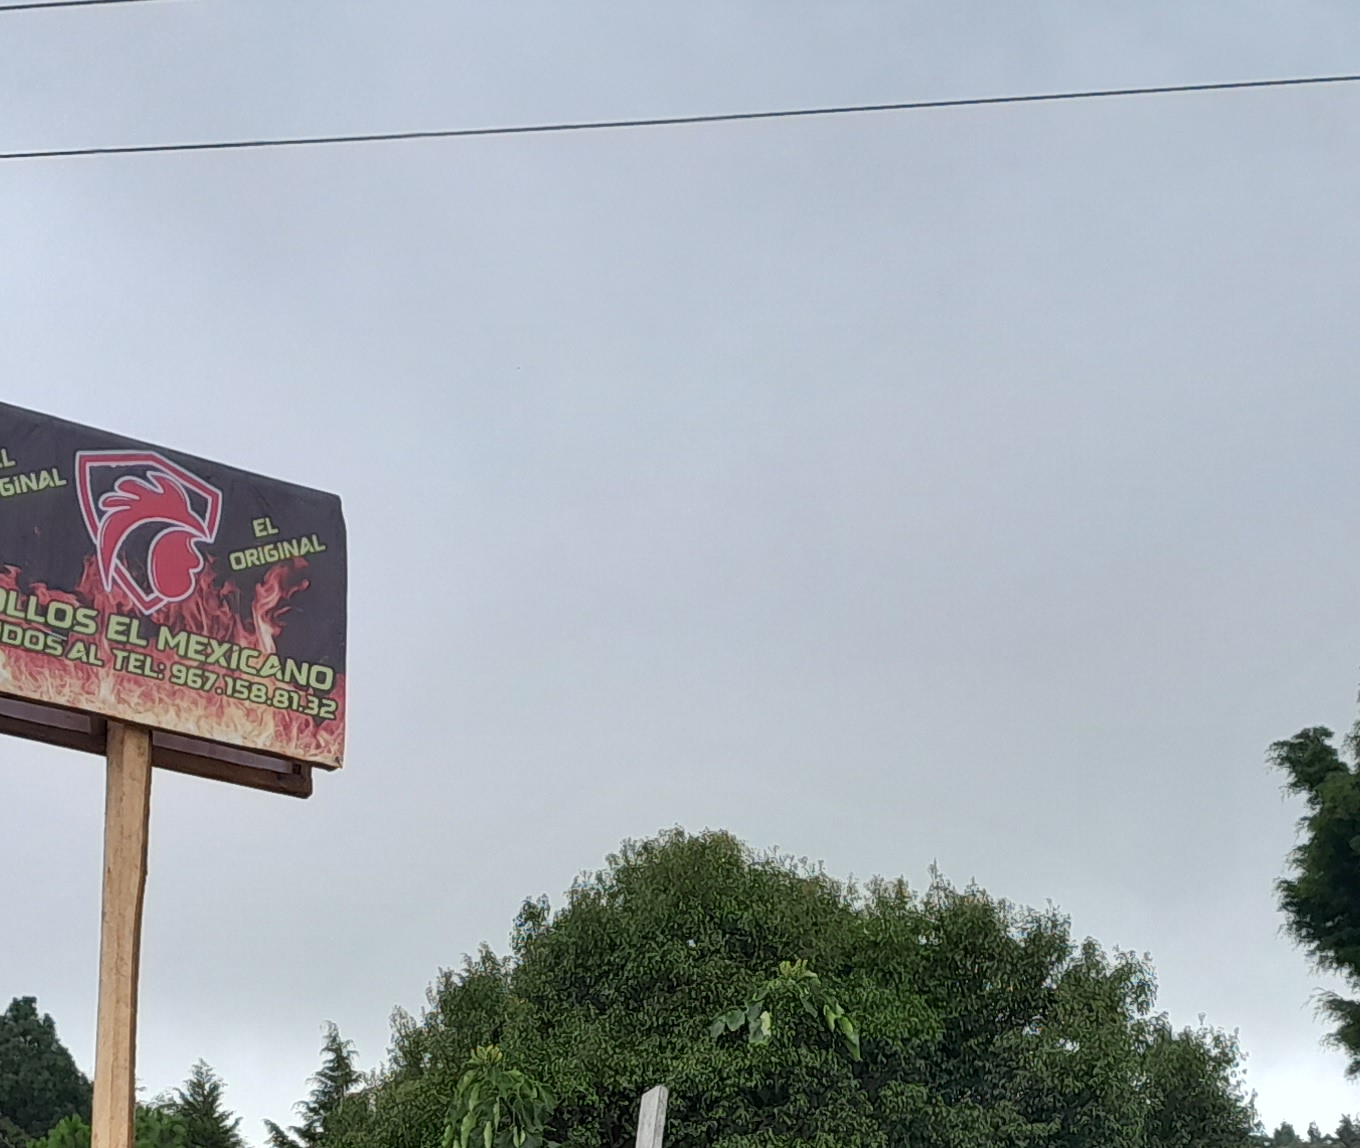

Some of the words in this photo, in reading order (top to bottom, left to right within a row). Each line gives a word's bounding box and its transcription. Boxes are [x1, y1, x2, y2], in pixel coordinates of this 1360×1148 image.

[229, 533, 327, 571] ORIGINAL
[252, 517, 279, 538] EL
[66, 641, 104, 666] AL
[111, 648, 166, 680] TEL:
[170, 663, 337, 720] 967.158.81.32
[106, 614, 148, 647] EL
[156, 625, 335, 691] MEXICANO
